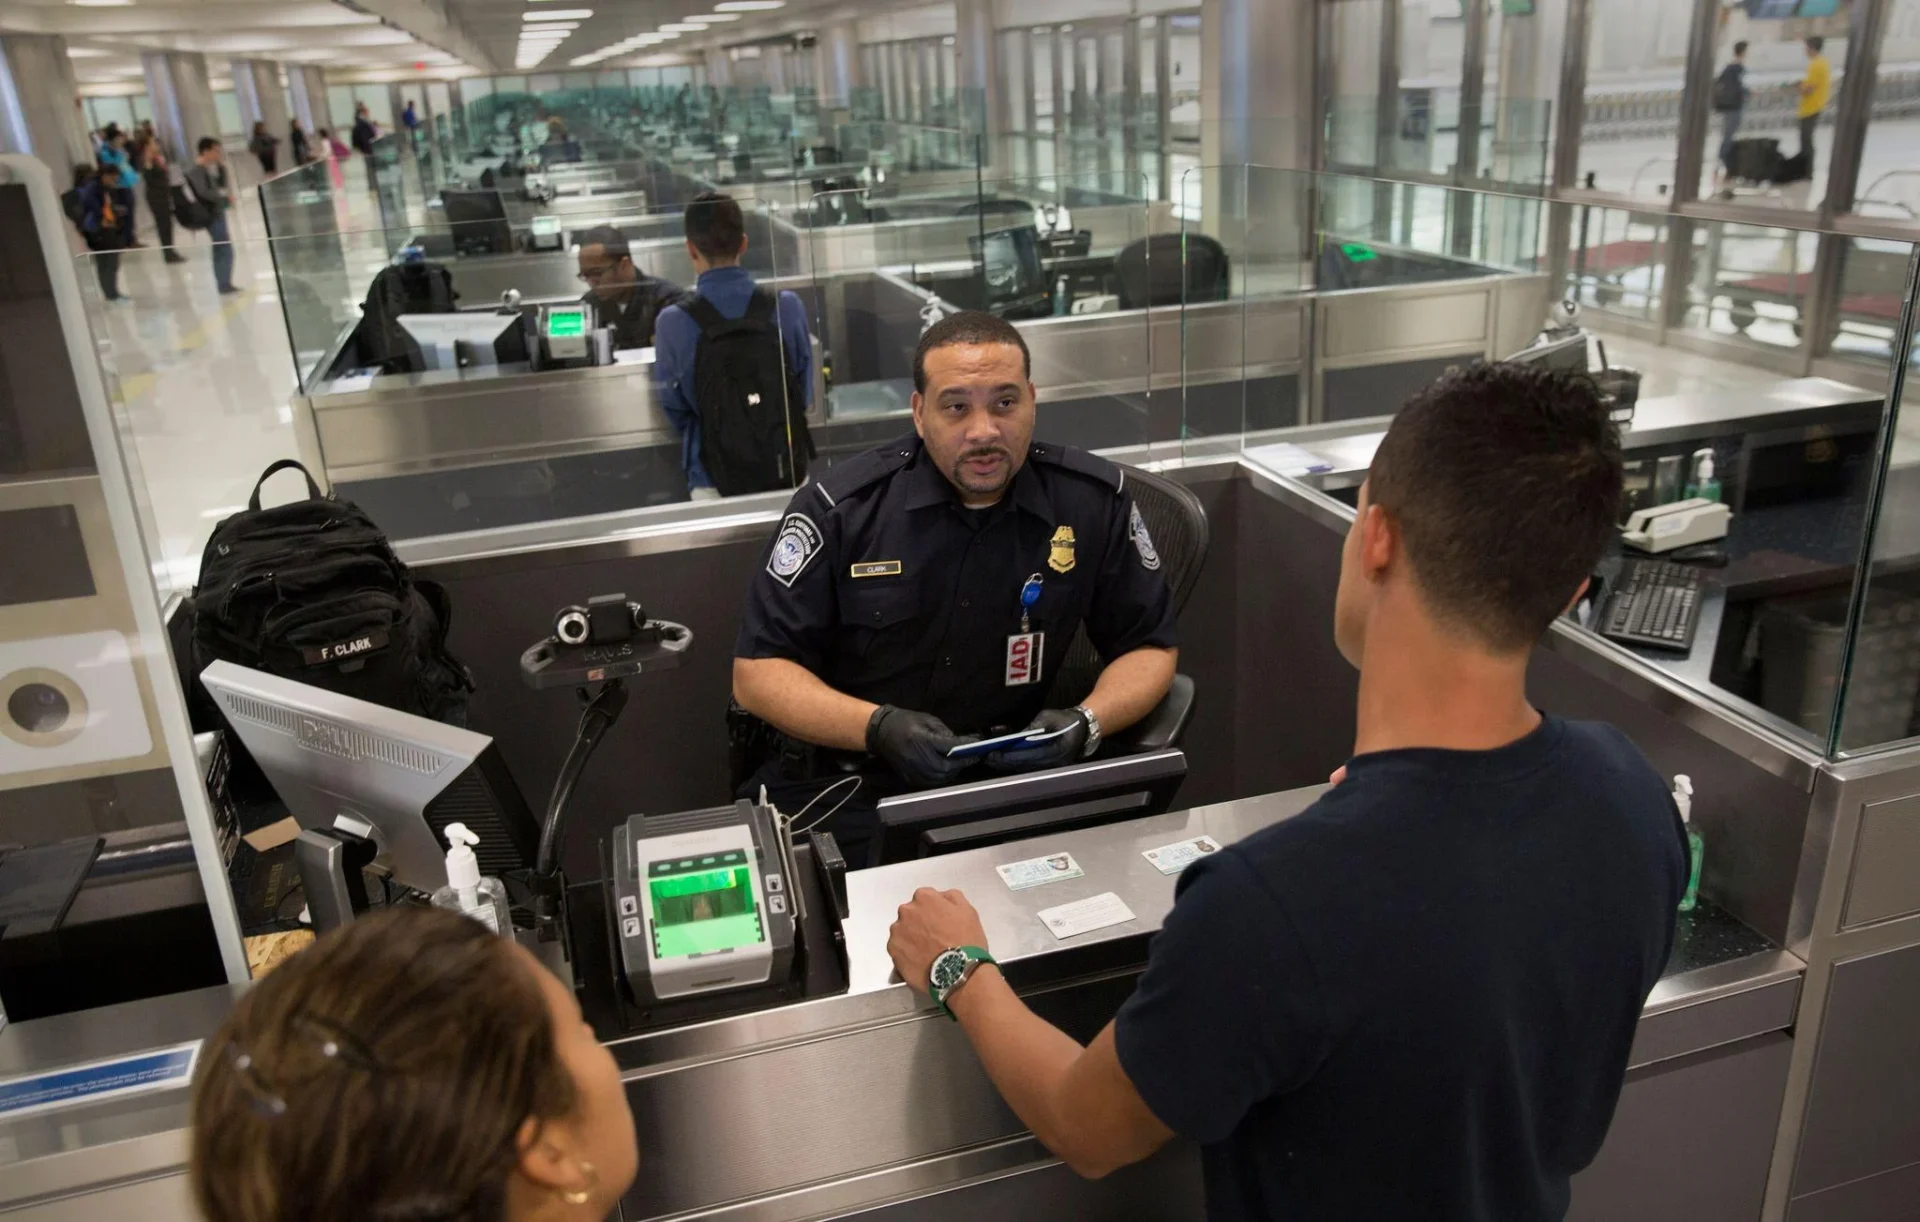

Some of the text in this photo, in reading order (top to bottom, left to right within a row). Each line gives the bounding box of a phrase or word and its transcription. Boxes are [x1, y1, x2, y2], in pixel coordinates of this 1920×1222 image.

[867, 565, 887, 573] CLARK
[321, 637, 372, 660] F. CLARK
[1010, 640, 1031, 680] IAD
